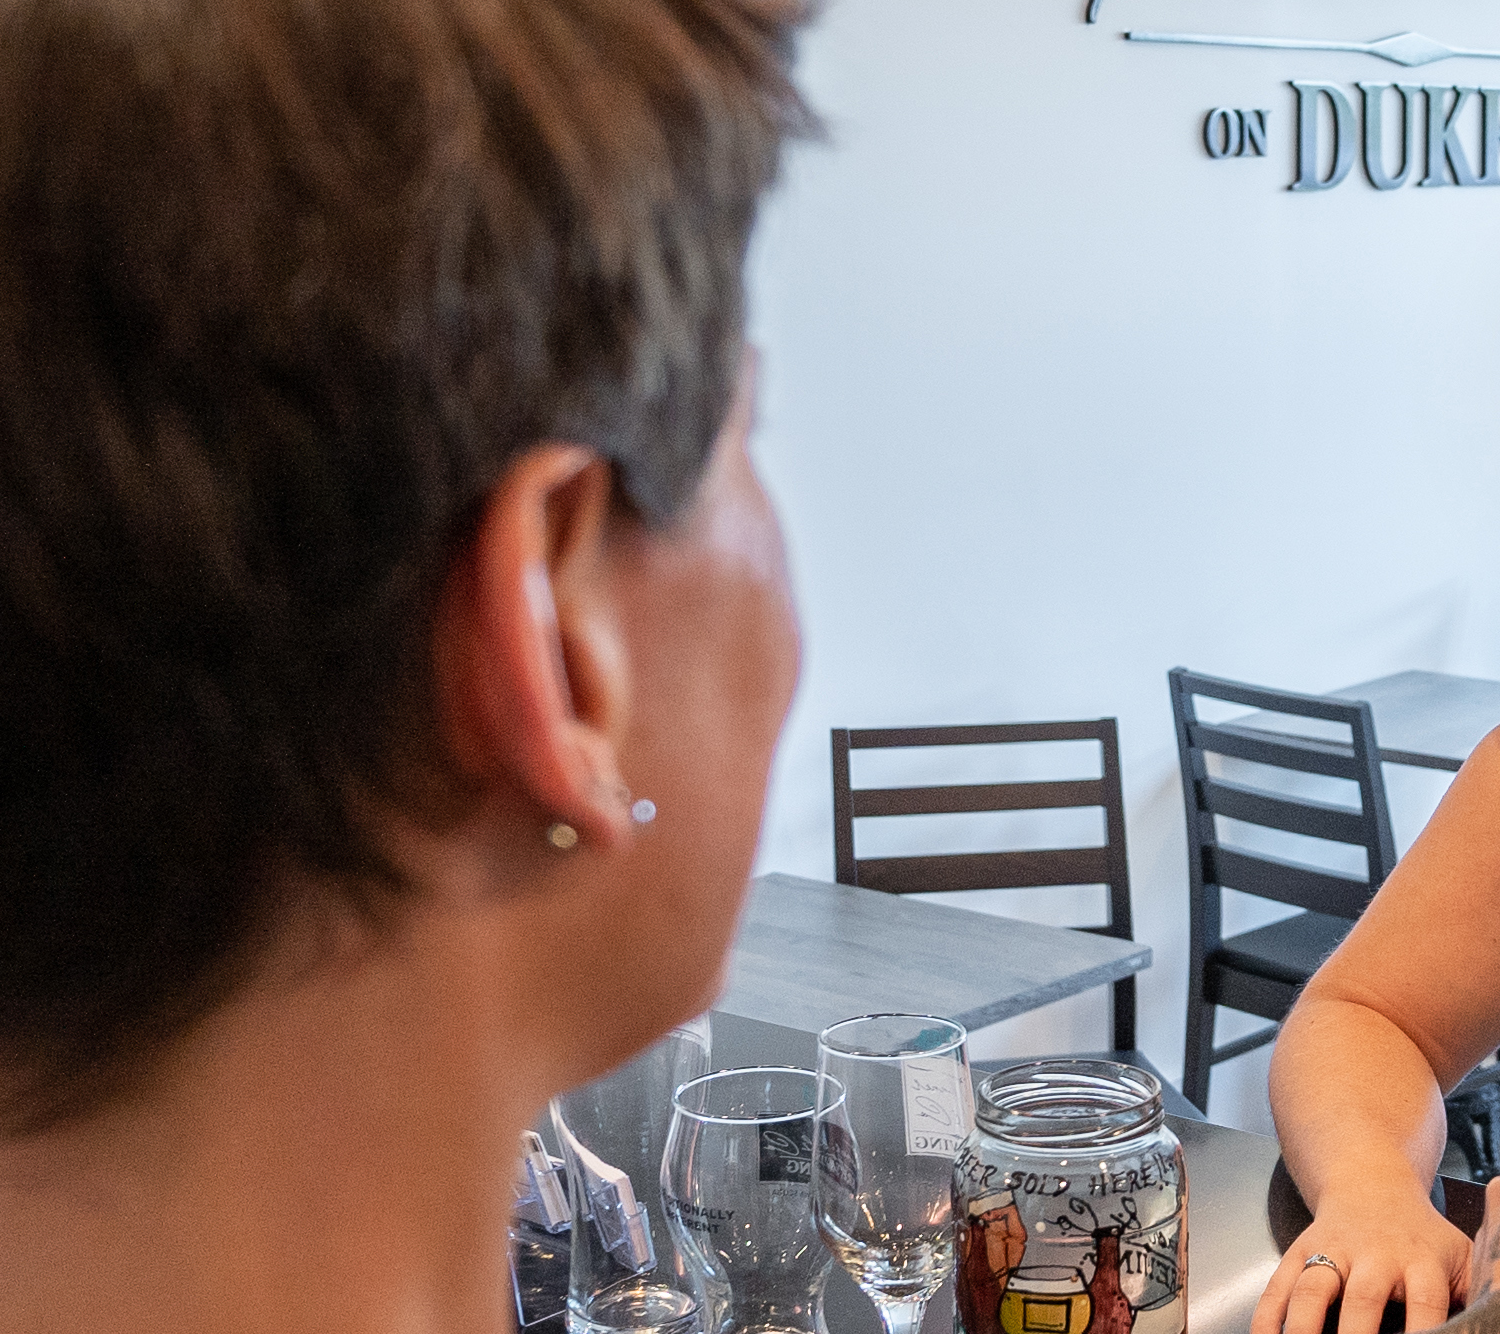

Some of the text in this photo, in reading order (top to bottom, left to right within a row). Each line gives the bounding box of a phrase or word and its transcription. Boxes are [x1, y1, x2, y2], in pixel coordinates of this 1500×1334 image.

[1202, 105, 1269, 160] ON
[954, 1147, 998, 1188] BEER
[1008, 1170, 1072, 1197] SOLD
